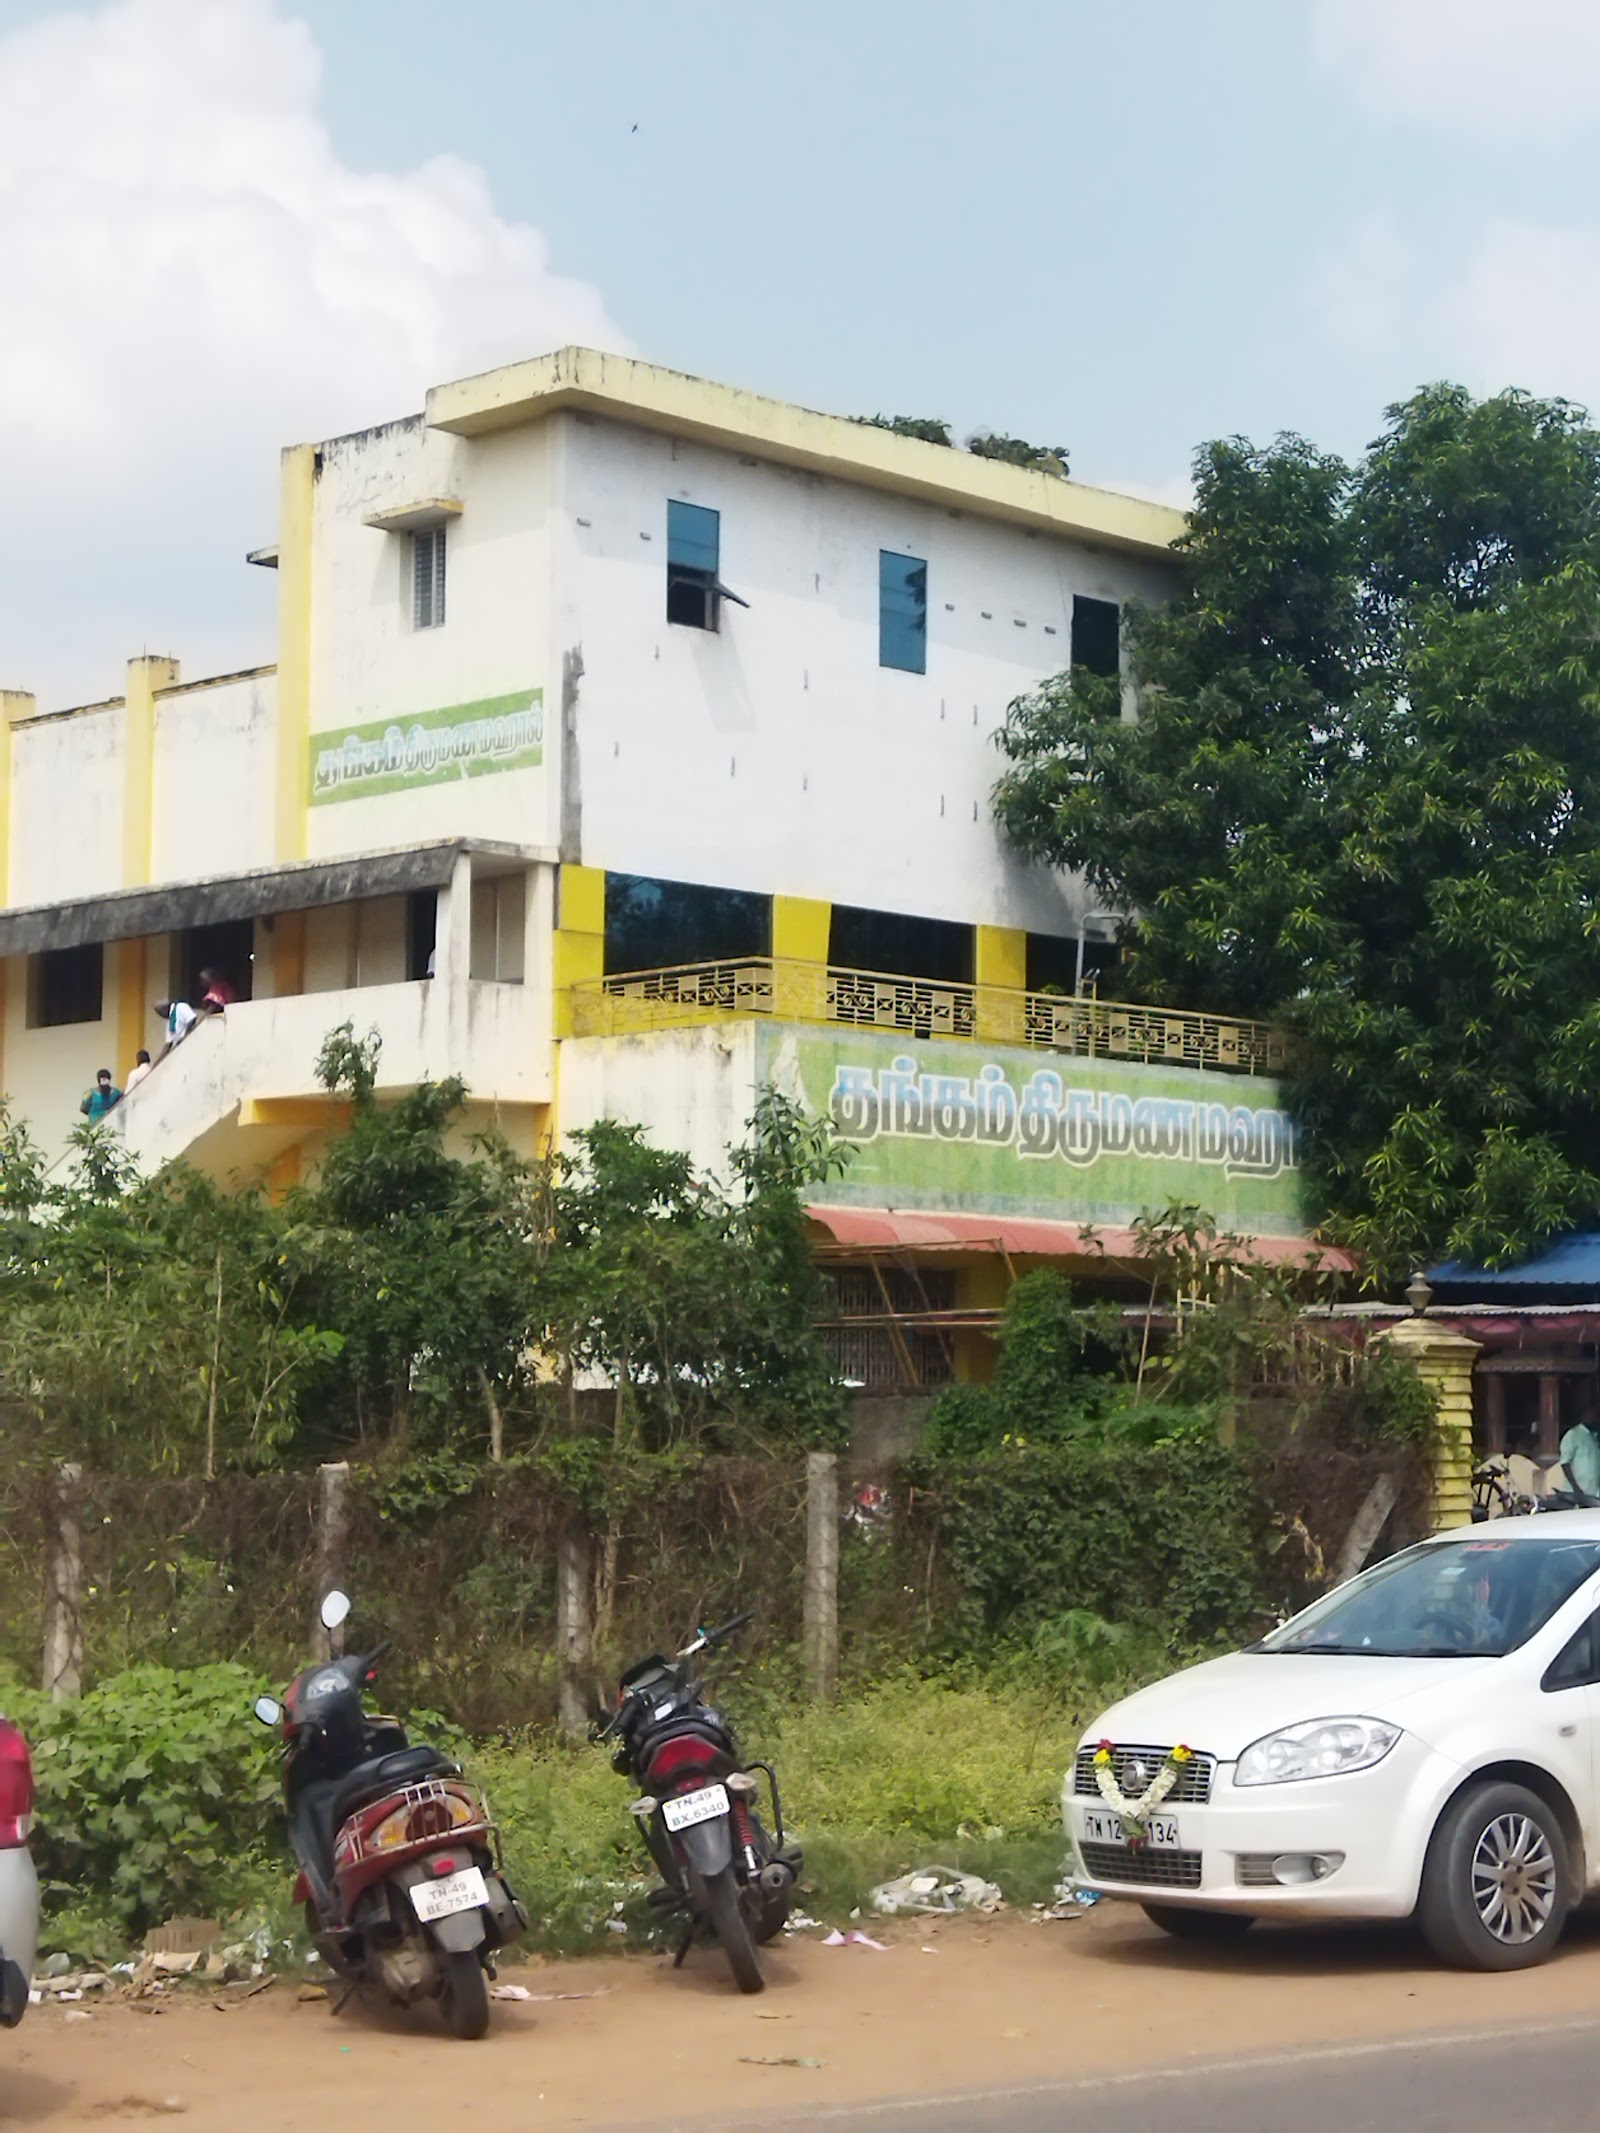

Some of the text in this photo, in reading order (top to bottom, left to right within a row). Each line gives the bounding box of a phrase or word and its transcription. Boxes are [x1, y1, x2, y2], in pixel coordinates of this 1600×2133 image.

[829, 1055, 1300, 1181] தங்கம் திருமண மஹா
[1087, 1816, 1103, 1838] TN
[1107, 1819, 1122, 1840] 12
